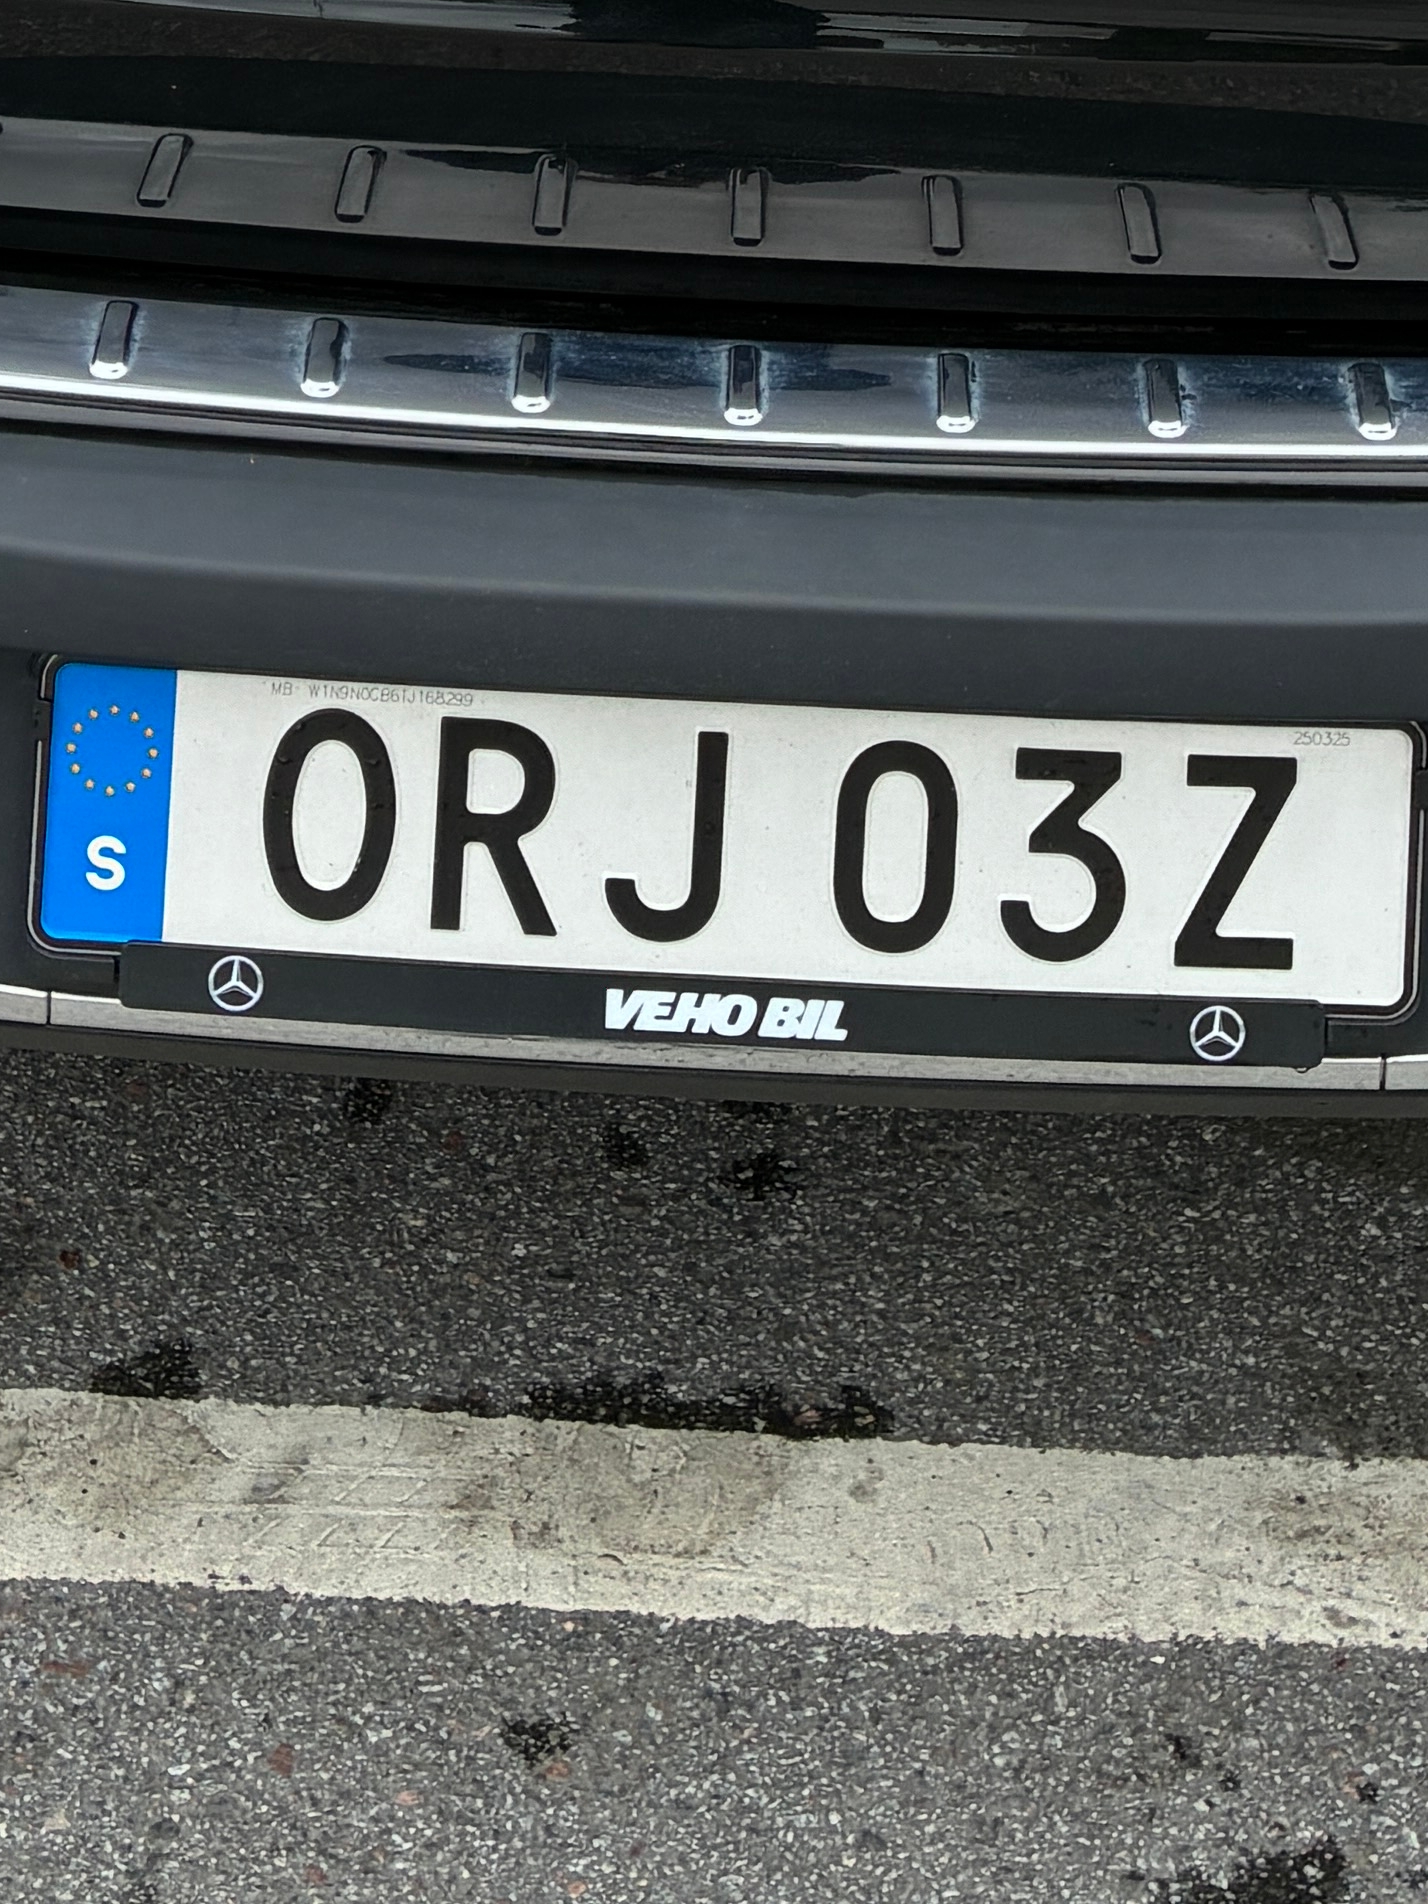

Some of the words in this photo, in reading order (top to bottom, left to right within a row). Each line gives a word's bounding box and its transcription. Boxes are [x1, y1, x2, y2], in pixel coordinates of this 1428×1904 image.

[1294, 731, 1351, 747] 250325
[84, 835, 128, 892] S
[262, 709, 730, 944] ORJ
[832, 740, 1301, 971] 03Z
[605, 988, 758, 1037] VEHO
[758, 997, 848, 1041] BIL
